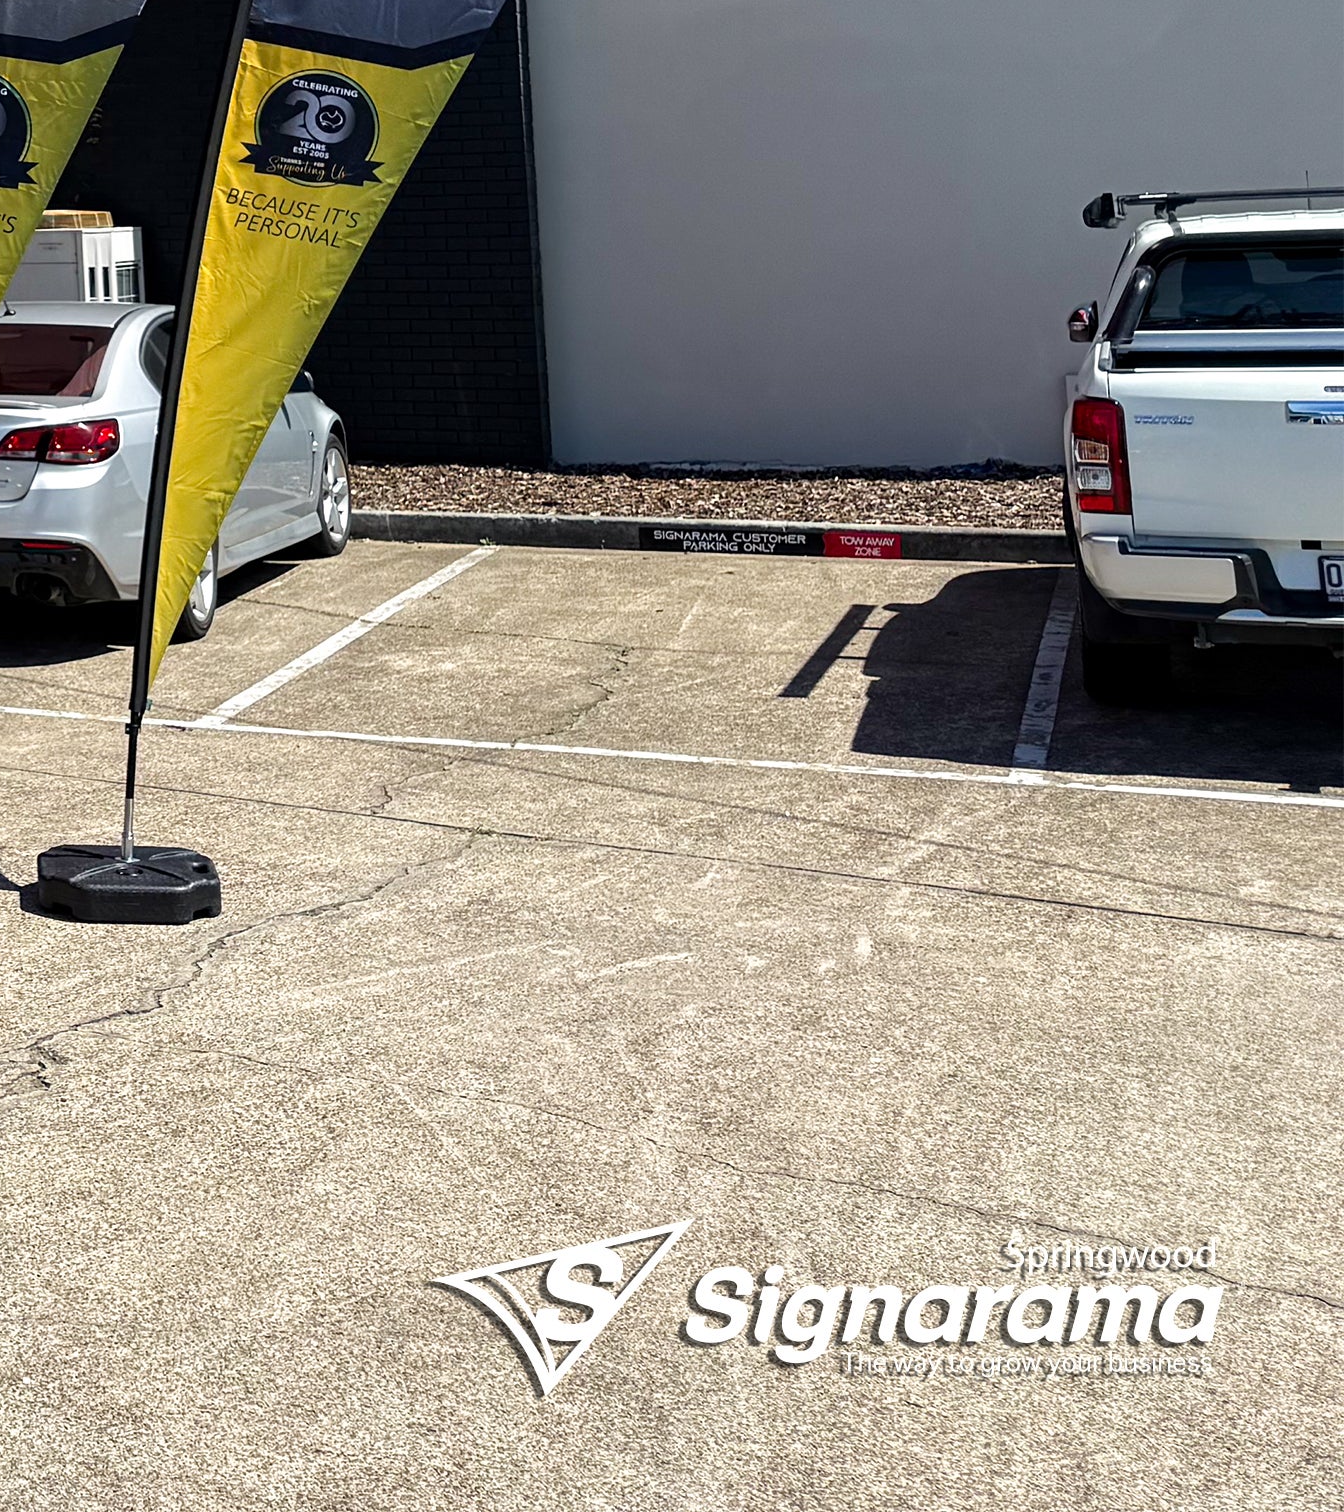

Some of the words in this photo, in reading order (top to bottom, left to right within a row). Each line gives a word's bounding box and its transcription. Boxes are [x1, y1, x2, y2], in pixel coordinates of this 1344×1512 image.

[292, 78, 359, 98] CELEBRATING
[279, 89, 356, 144] 20
[293, 146, 308, 155] EST
[309, 148, 330, 159] 2005
[299, 140, 327, 151] YEARS
[265, 155, 326, 182] Supporting
[226, 187, 321, 222] BECAUSE
[323, 206, 361, 229] IT'S
[234, 212, 342, 249] PERSONAL
[653, 530, 728, 542] SIGNARAMA
[732, 532, 807, 545] CUSTOMER
[839, 536, 864, 546] TOW
[865, 536, 895, 547] AWAY
[683, 540, 739, 552] PARKING
[743, 542, 776, 554] ONLY
[854, 546, 882, 557] ZONE
